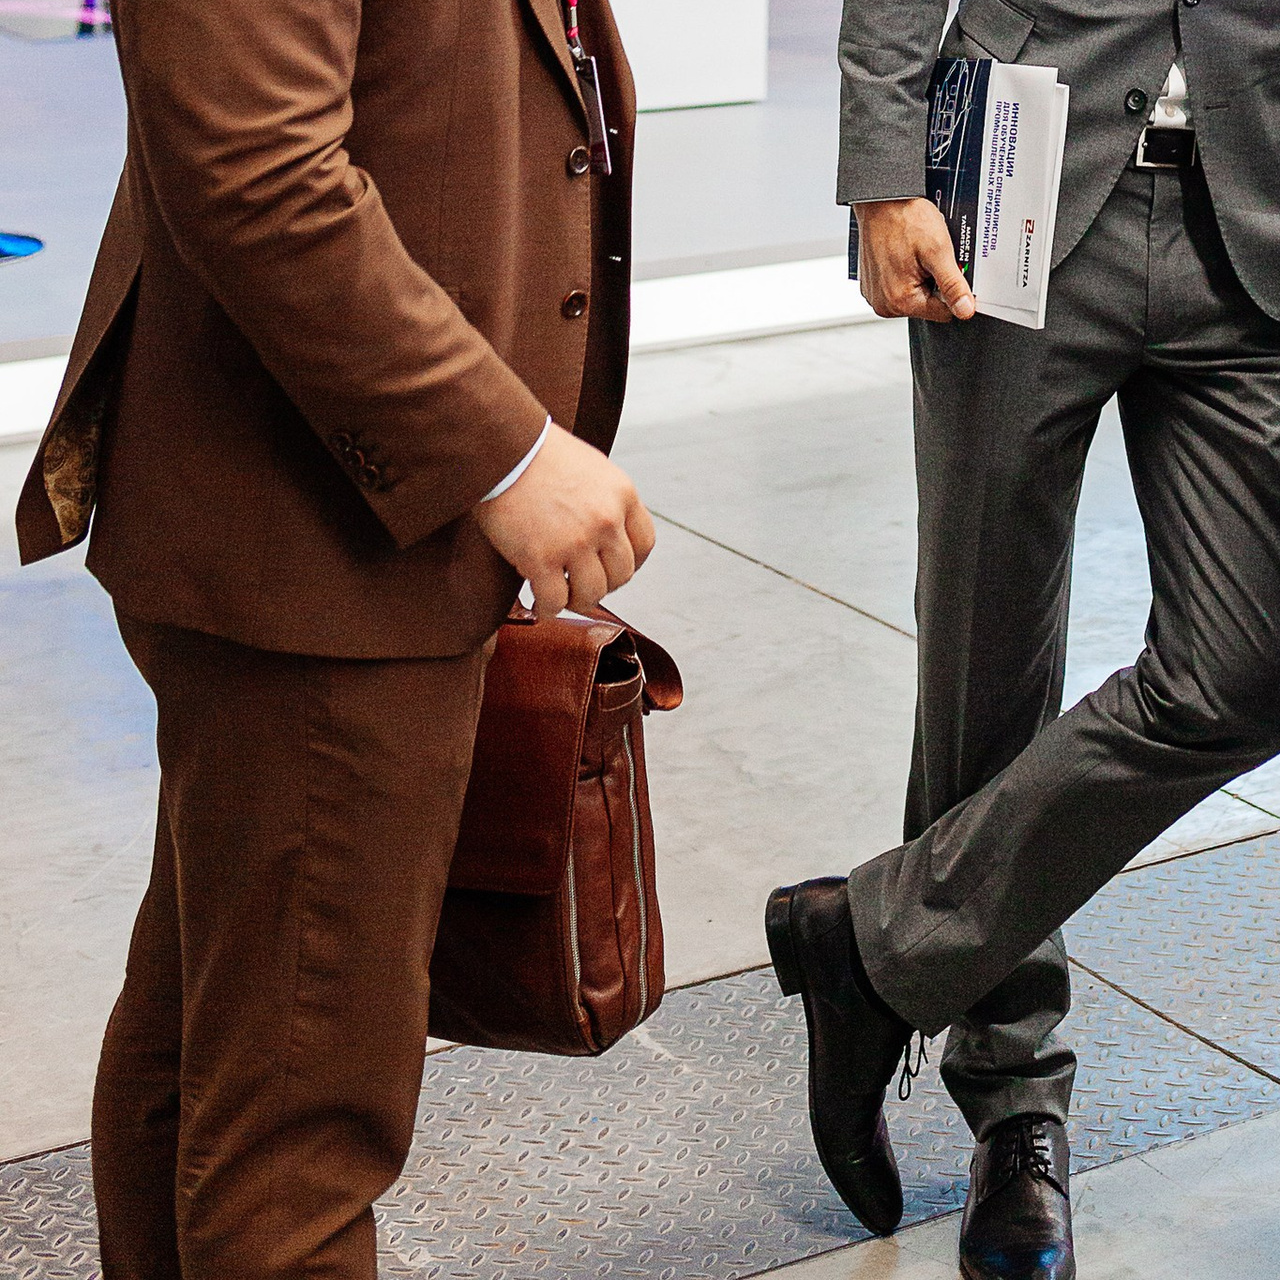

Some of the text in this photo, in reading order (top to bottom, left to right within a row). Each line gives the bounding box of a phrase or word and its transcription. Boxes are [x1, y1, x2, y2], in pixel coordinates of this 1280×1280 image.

[987, 100, 1002, 186] ПРОМЫШЛЕННЫХ
[990, 101, 1010, 251] ДЛЯ ОБУЧЕНИЯ СПЕЦИАЛИСТОВ
[1005, 102, 1020, 178] ИННОВАЦИИ
[959, 214, 967, 262] TATARSTAN
[1022, 234, 1031, 288] ZARNITZA
